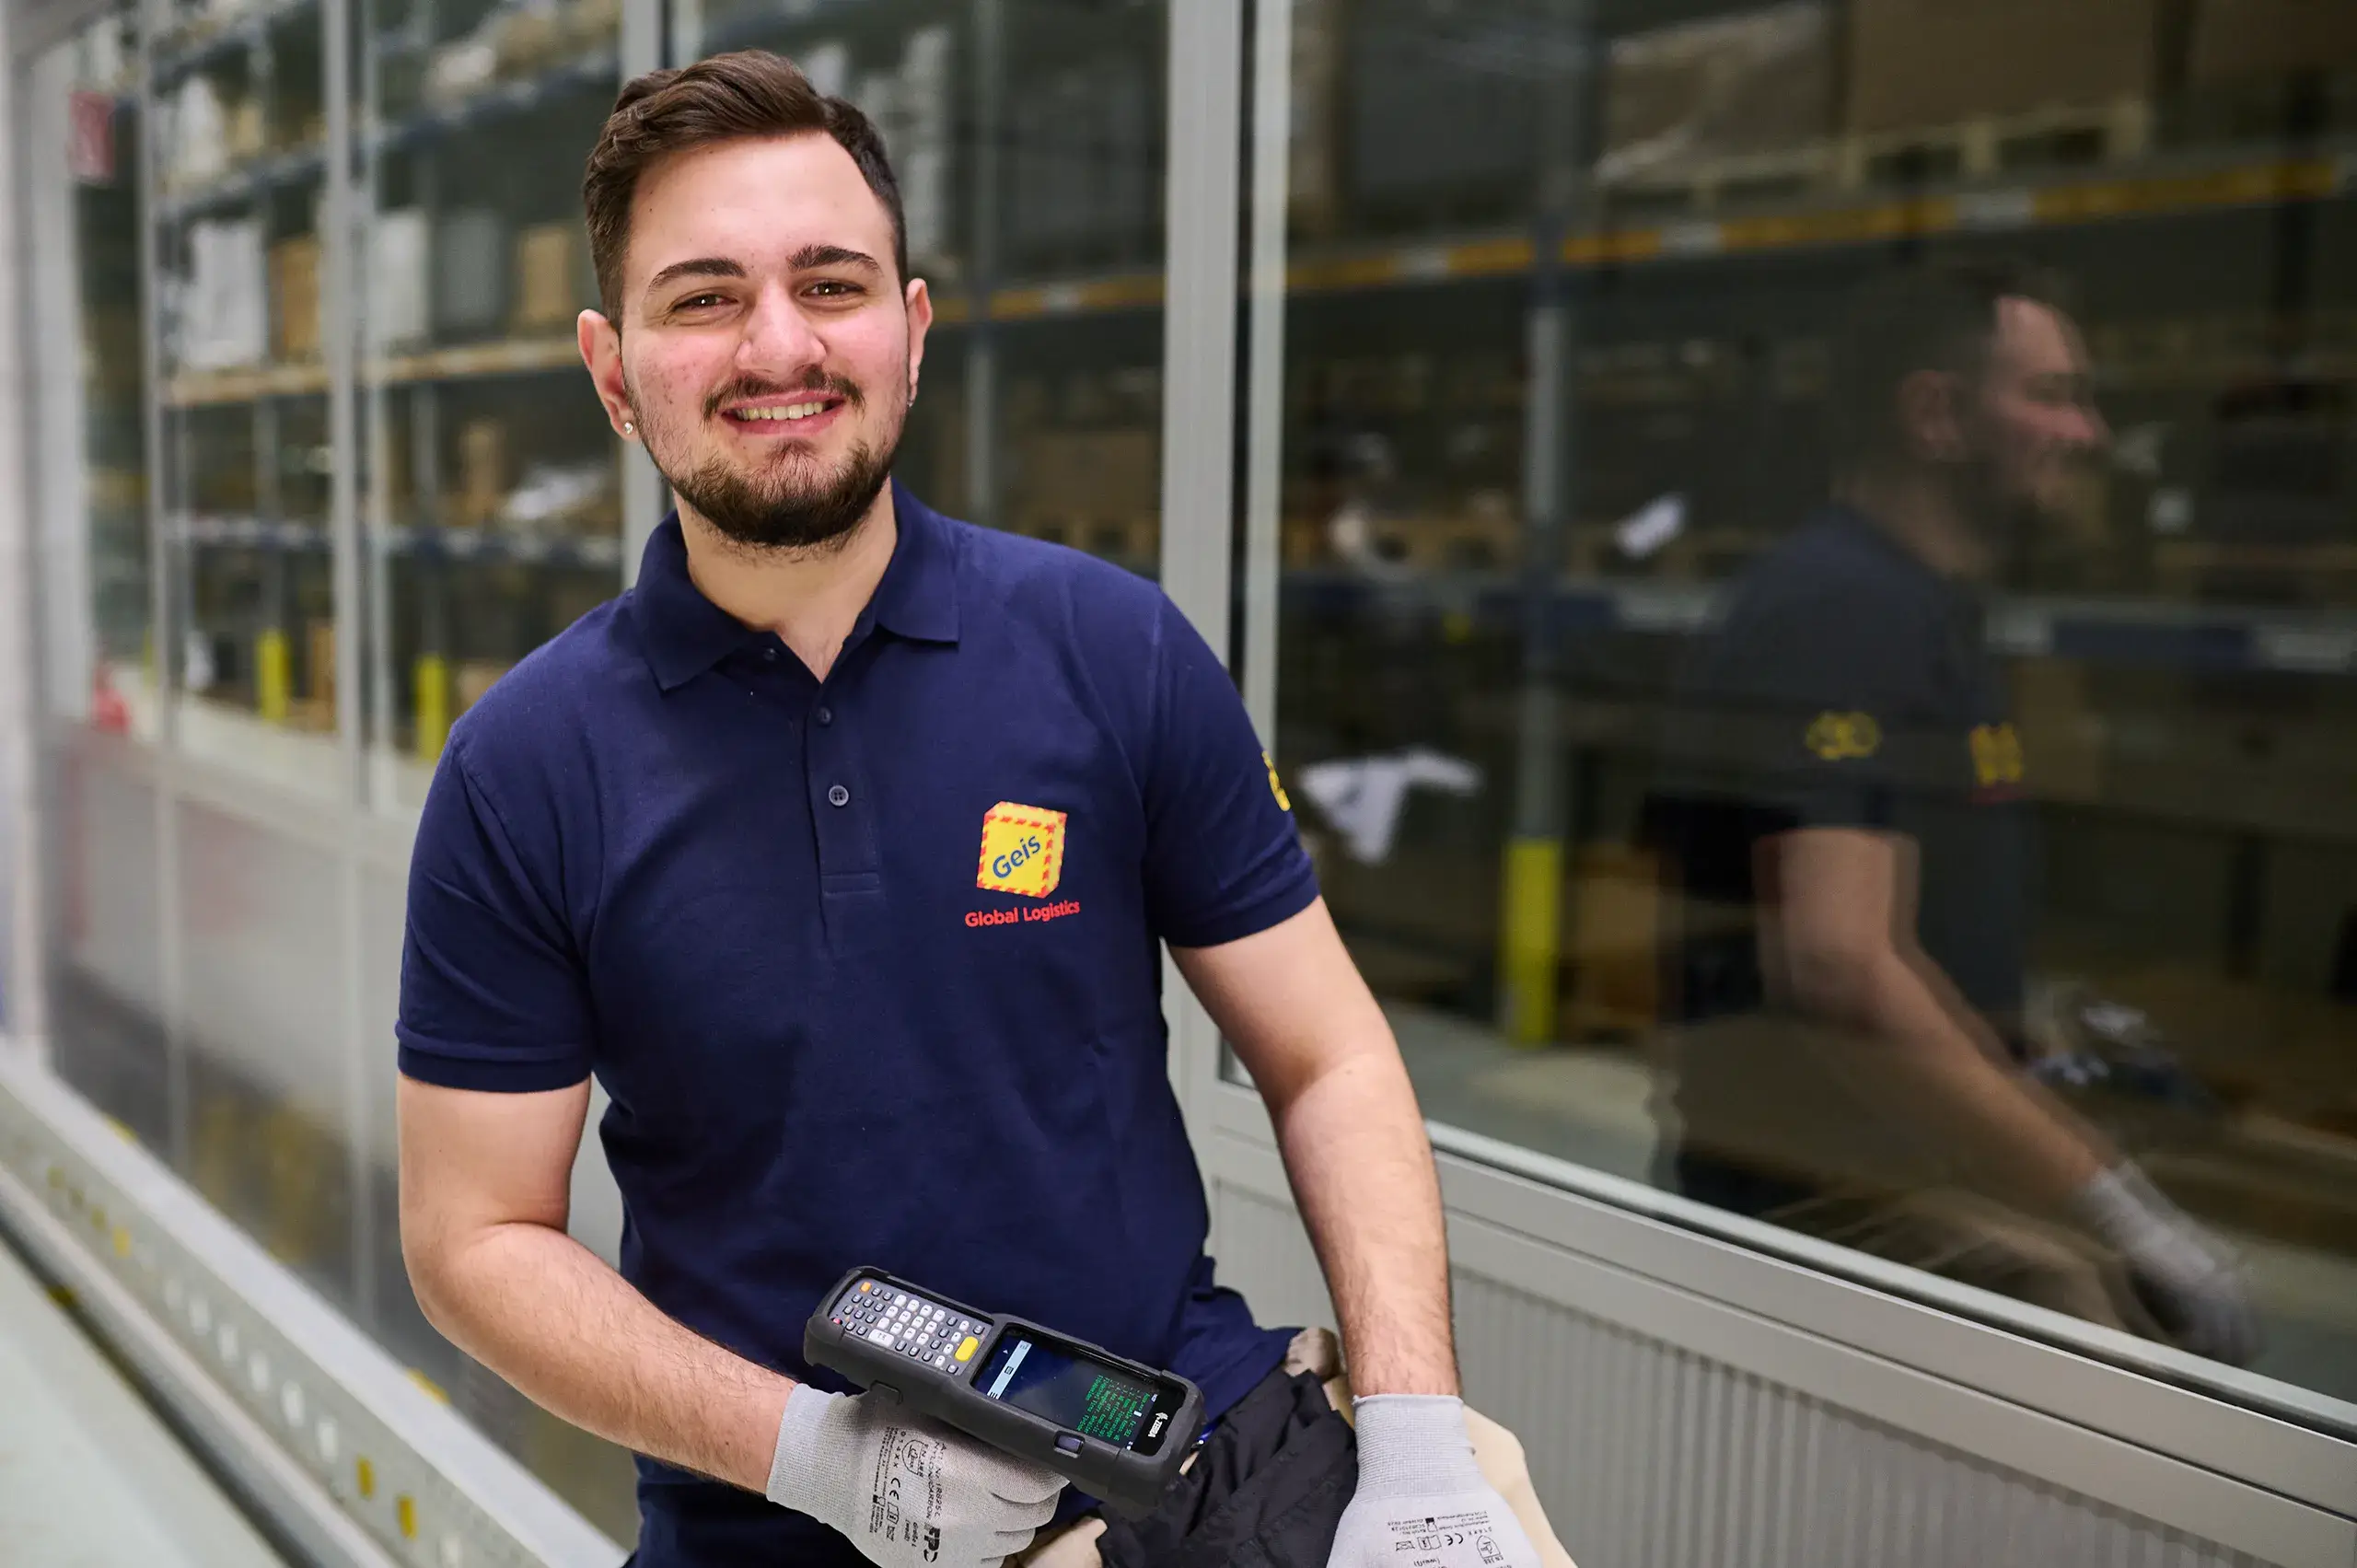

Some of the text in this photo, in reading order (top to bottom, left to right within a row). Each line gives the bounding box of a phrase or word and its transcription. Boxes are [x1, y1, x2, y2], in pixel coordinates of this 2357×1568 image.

[993, 835, 1041, 878] Geis
[964, 900, 1081, 927] Global Logistics
